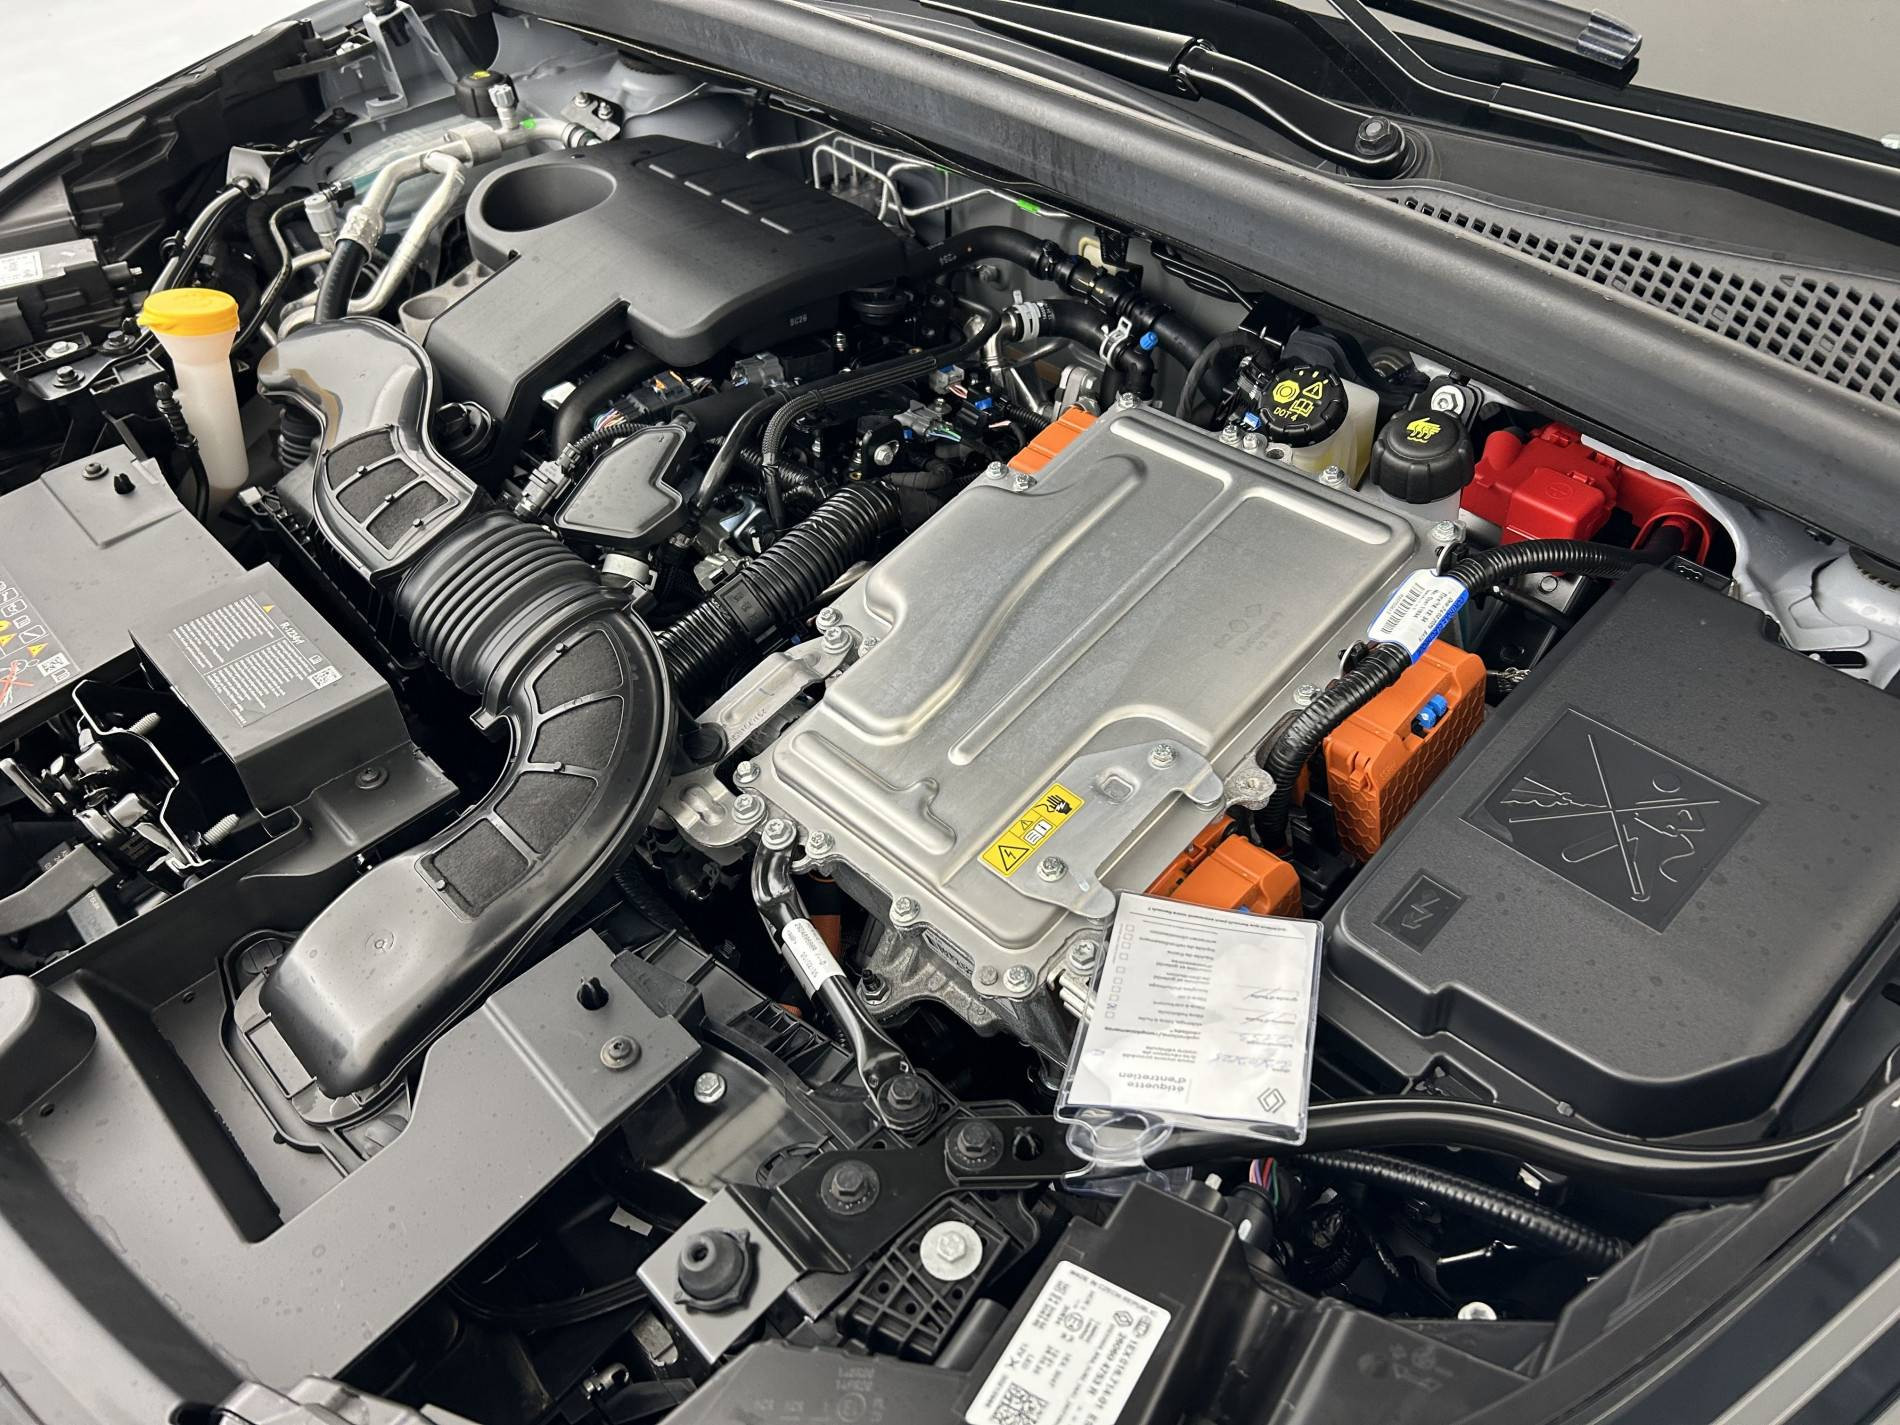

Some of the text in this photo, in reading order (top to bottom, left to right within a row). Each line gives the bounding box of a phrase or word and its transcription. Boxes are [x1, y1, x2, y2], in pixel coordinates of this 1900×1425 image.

[1274, 407, 1298, 421] DOT 4
[1119, 1072, 1186, 1083] d'entretien
[1127, 1082, 1184, 1092] étiquette
